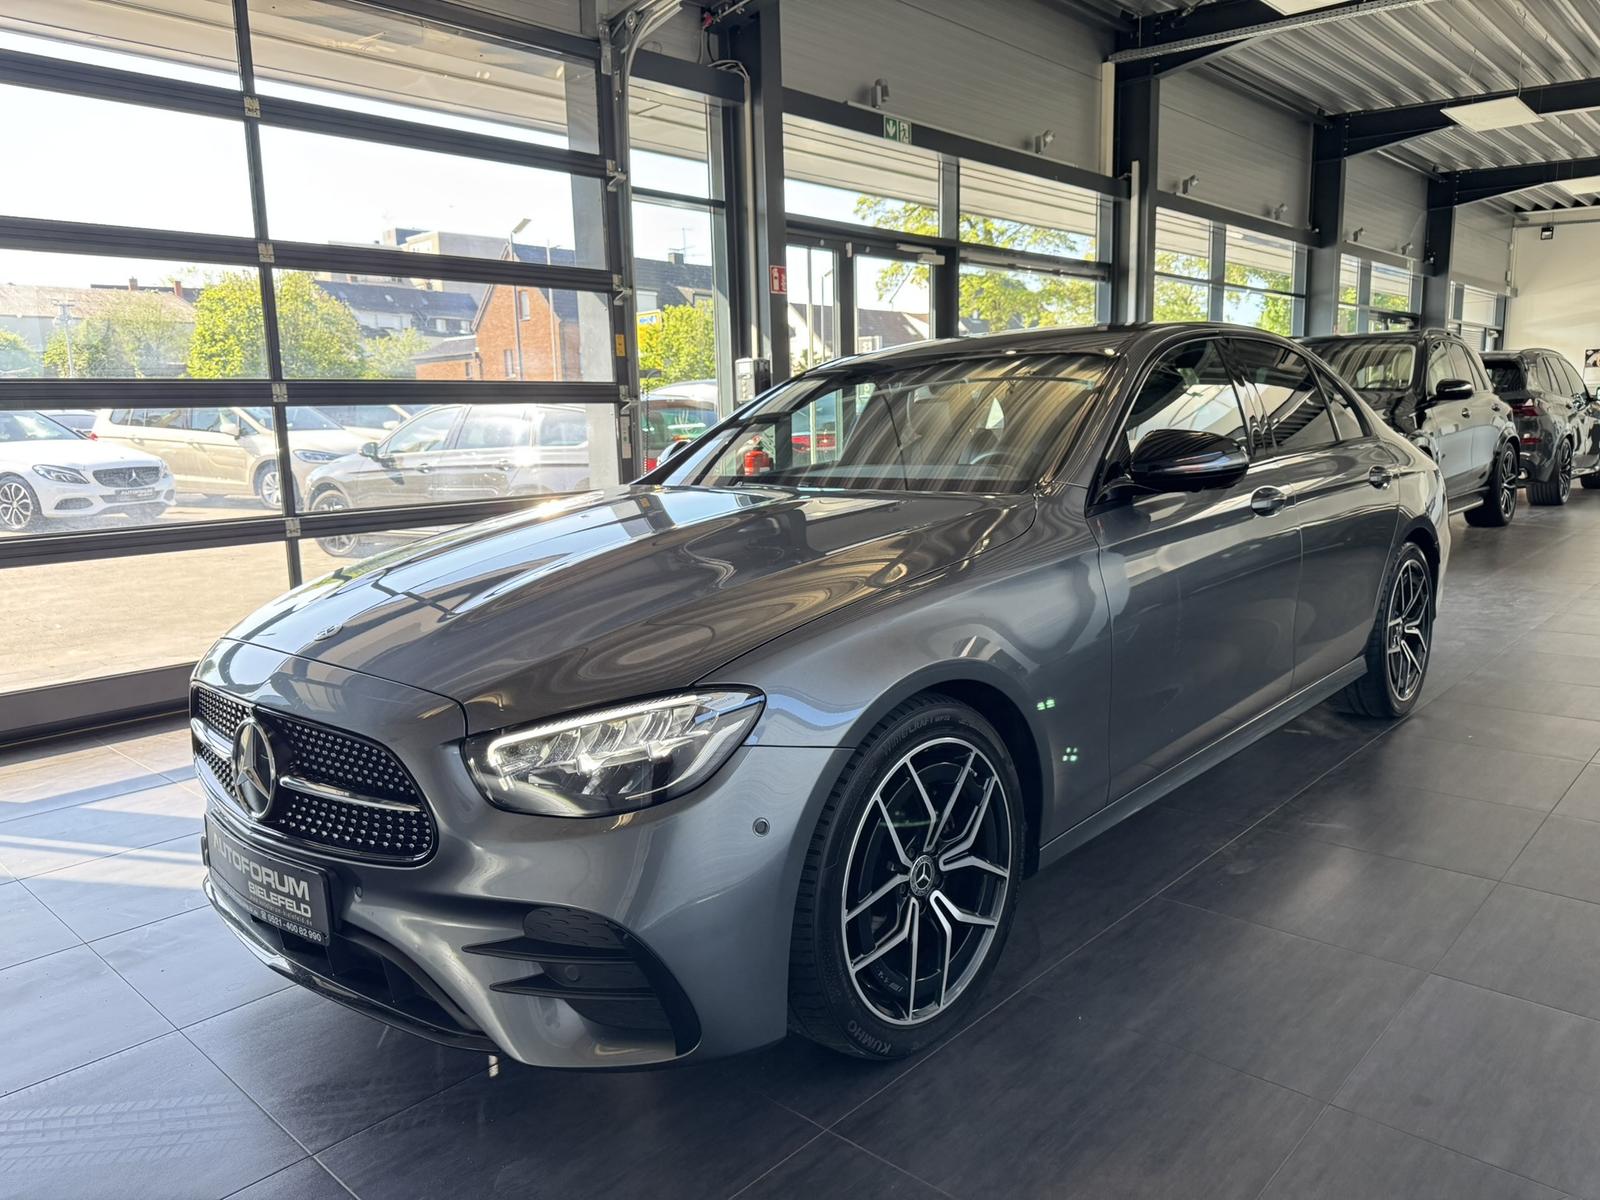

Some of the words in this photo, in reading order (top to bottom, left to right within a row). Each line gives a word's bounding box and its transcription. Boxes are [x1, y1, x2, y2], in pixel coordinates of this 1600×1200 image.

[212, 832, 310, 901] AUTOFORUM
[248, 880, 312, 918] BIELEFELD
[847, 1019, 892, 1056] KUMHO
